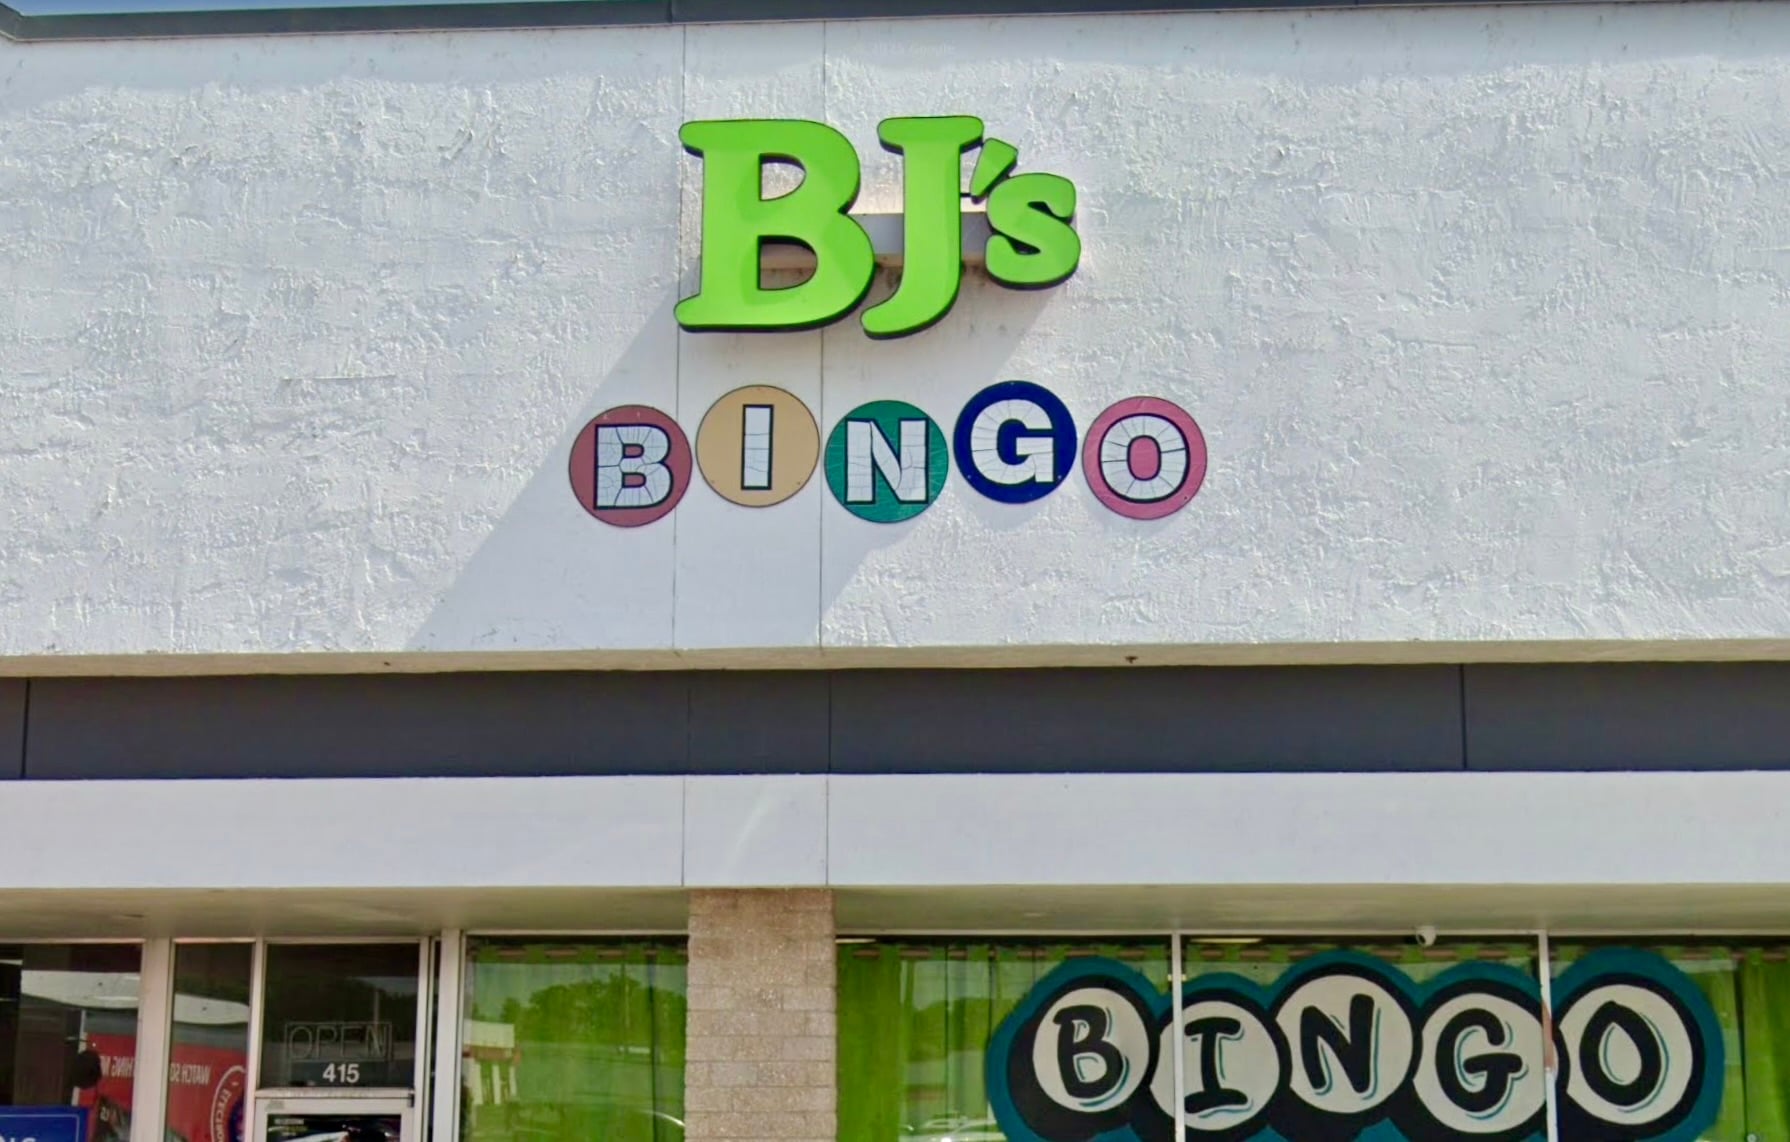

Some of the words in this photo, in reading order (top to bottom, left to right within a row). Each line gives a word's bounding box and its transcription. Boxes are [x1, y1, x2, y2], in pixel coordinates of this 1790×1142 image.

[674, 115, 1081, 339] BJ's
[594, 398, 1191, 509] BINGO
[288, 1025, 388, 1060] OPEN
[322, 1062, 361, 1084] 415
[1053, 993, 1669, 1120] BINGO
